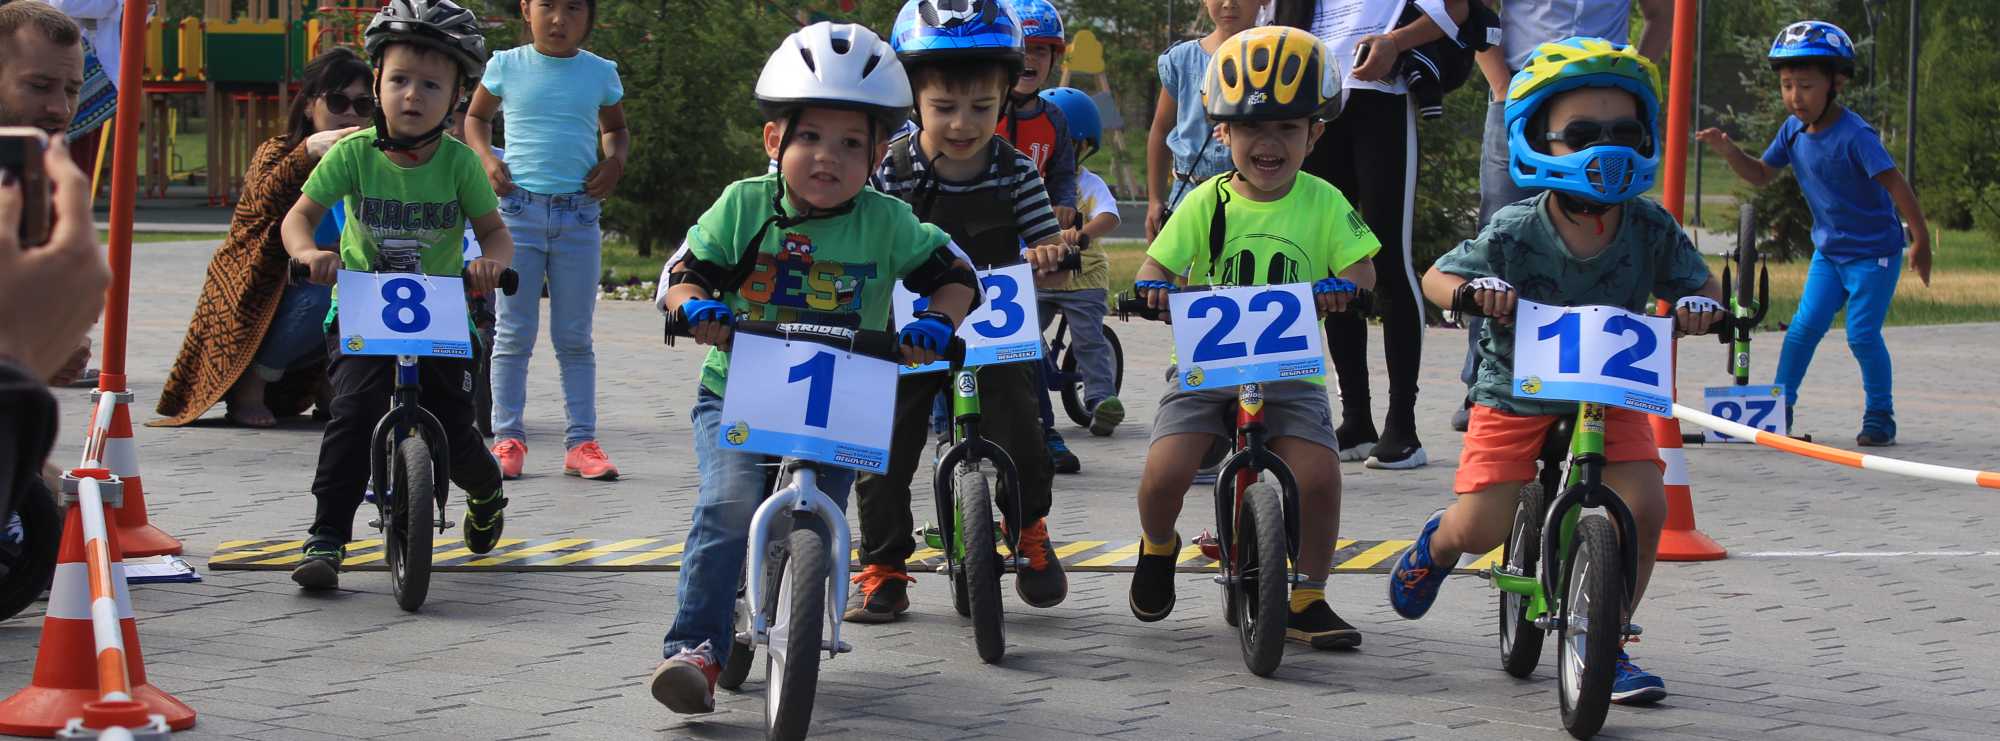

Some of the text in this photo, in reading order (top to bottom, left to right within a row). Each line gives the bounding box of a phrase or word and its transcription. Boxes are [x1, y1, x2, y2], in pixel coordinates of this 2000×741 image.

[381, 277, 431, 333] 8
[740, 251, 878, 311] BEST
[777, 322, 857, 339] STRIDER
[1187, 290, 1308, 363] 22
[1537, 312, 1659, 387] 12
[787, 350, 836, 429] 1
